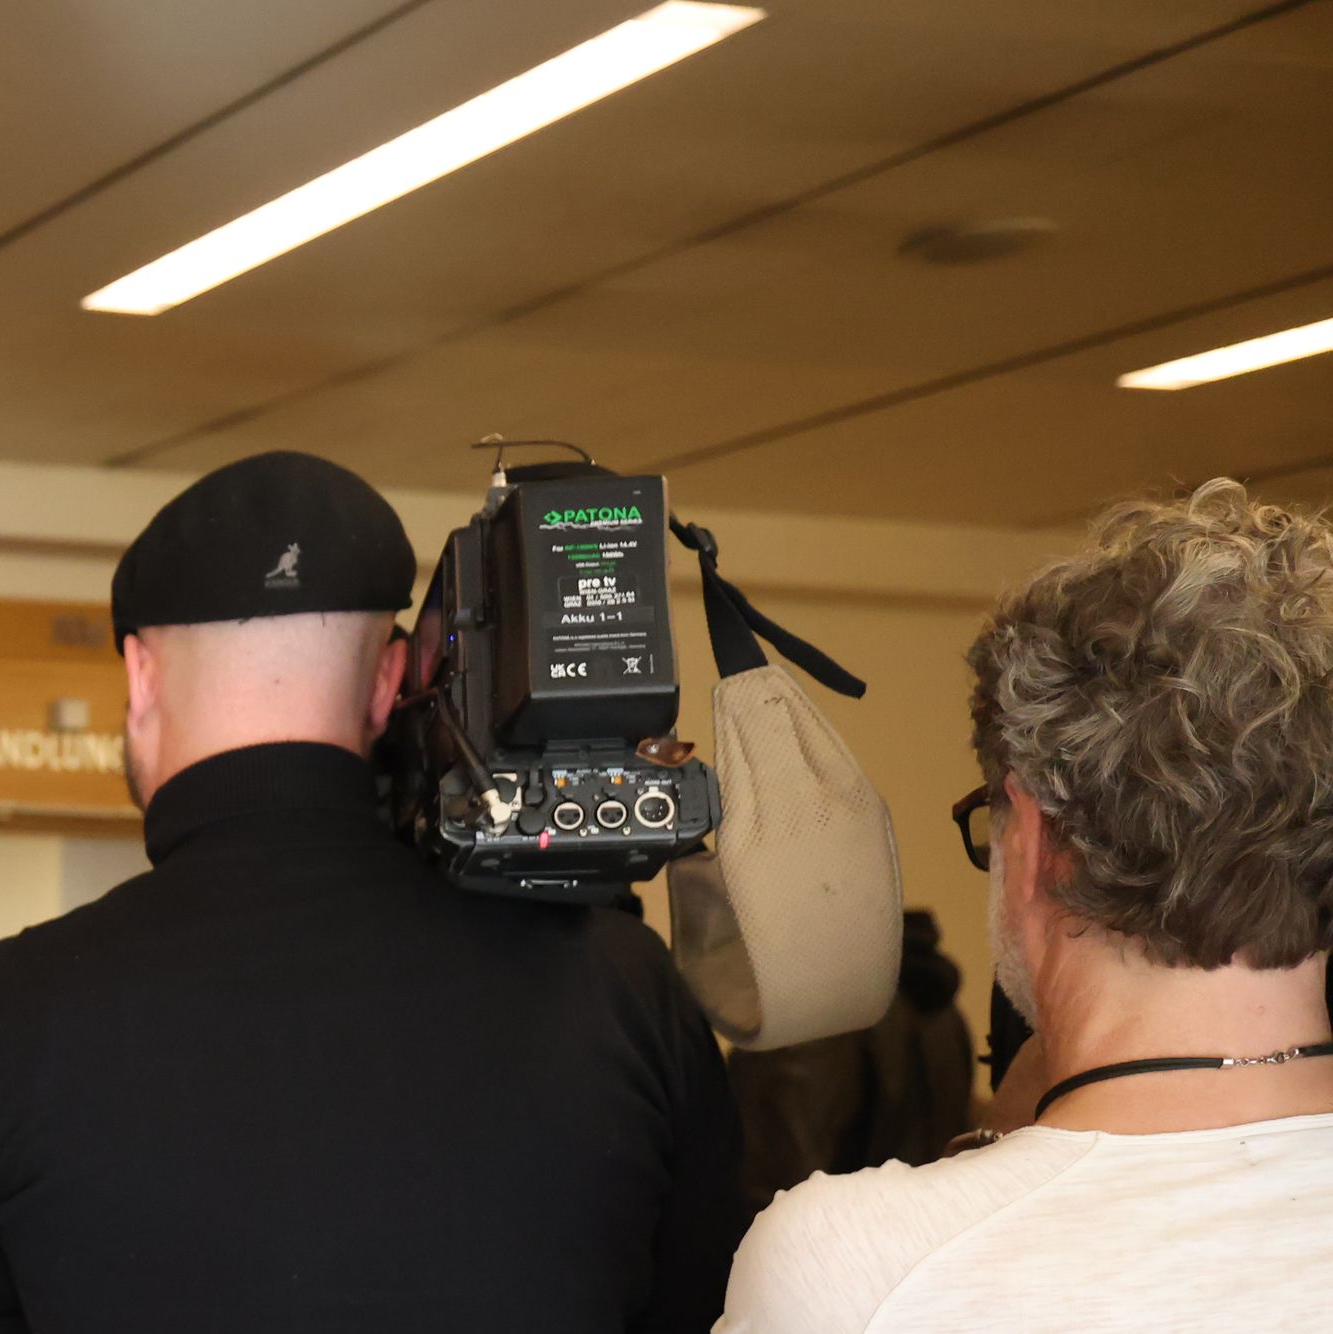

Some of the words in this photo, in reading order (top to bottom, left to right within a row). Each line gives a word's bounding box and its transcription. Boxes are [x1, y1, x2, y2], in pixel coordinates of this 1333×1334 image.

[563, 506, 642, 523] PATONA
[603, 576, 616, 587] tv
[561, 613, 595, 624] Akku
